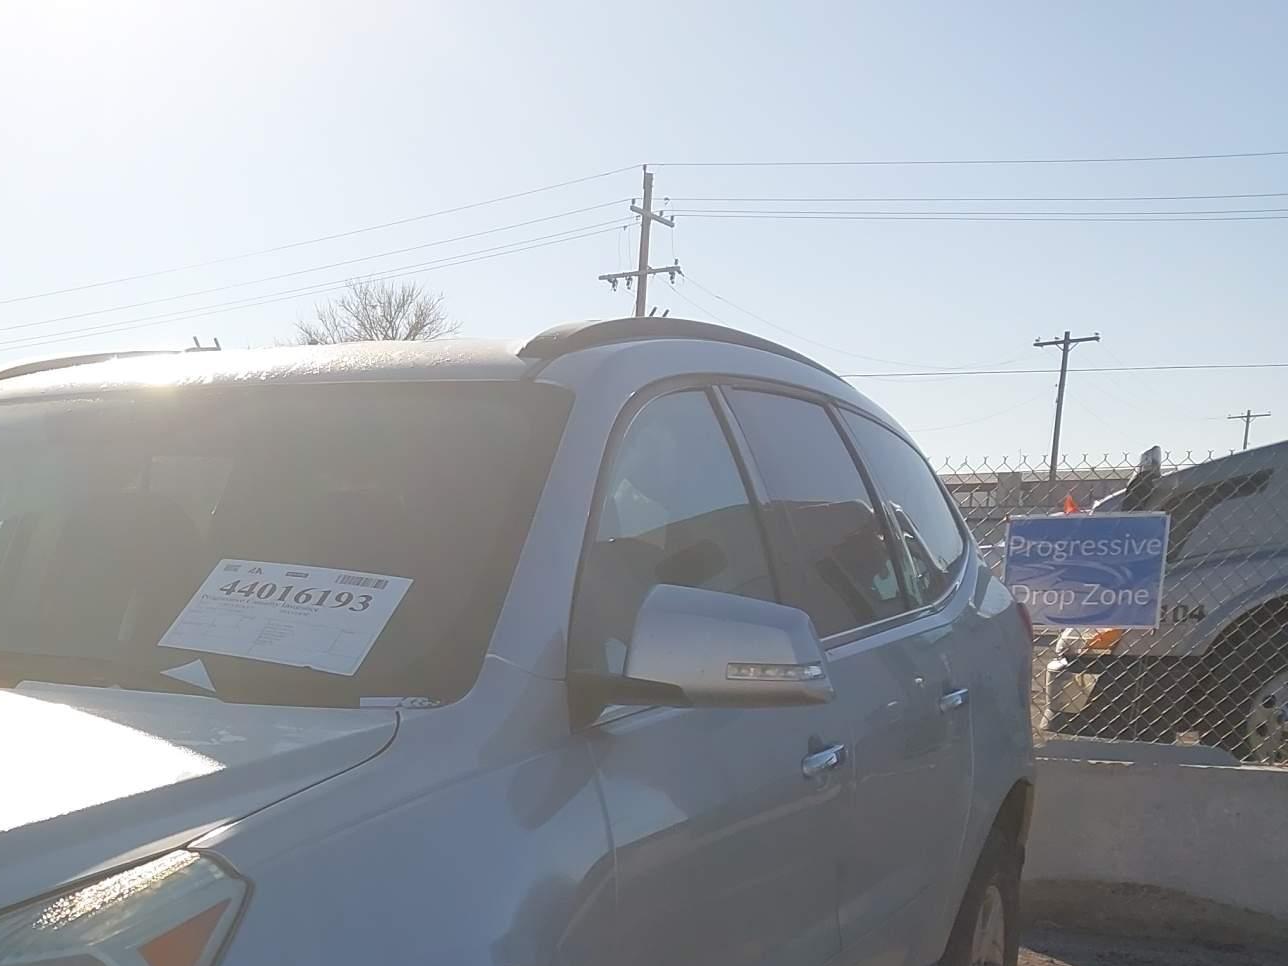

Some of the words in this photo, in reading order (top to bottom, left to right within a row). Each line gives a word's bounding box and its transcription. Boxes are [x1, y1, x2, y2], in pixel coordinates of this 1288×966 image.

[1008, 533, 1162, 561] Progressive
[220, 579, 373, 612] 44016193
[1011, 584, 1075, 610] Drop
[1081, 583, 1149, 606] Zone
